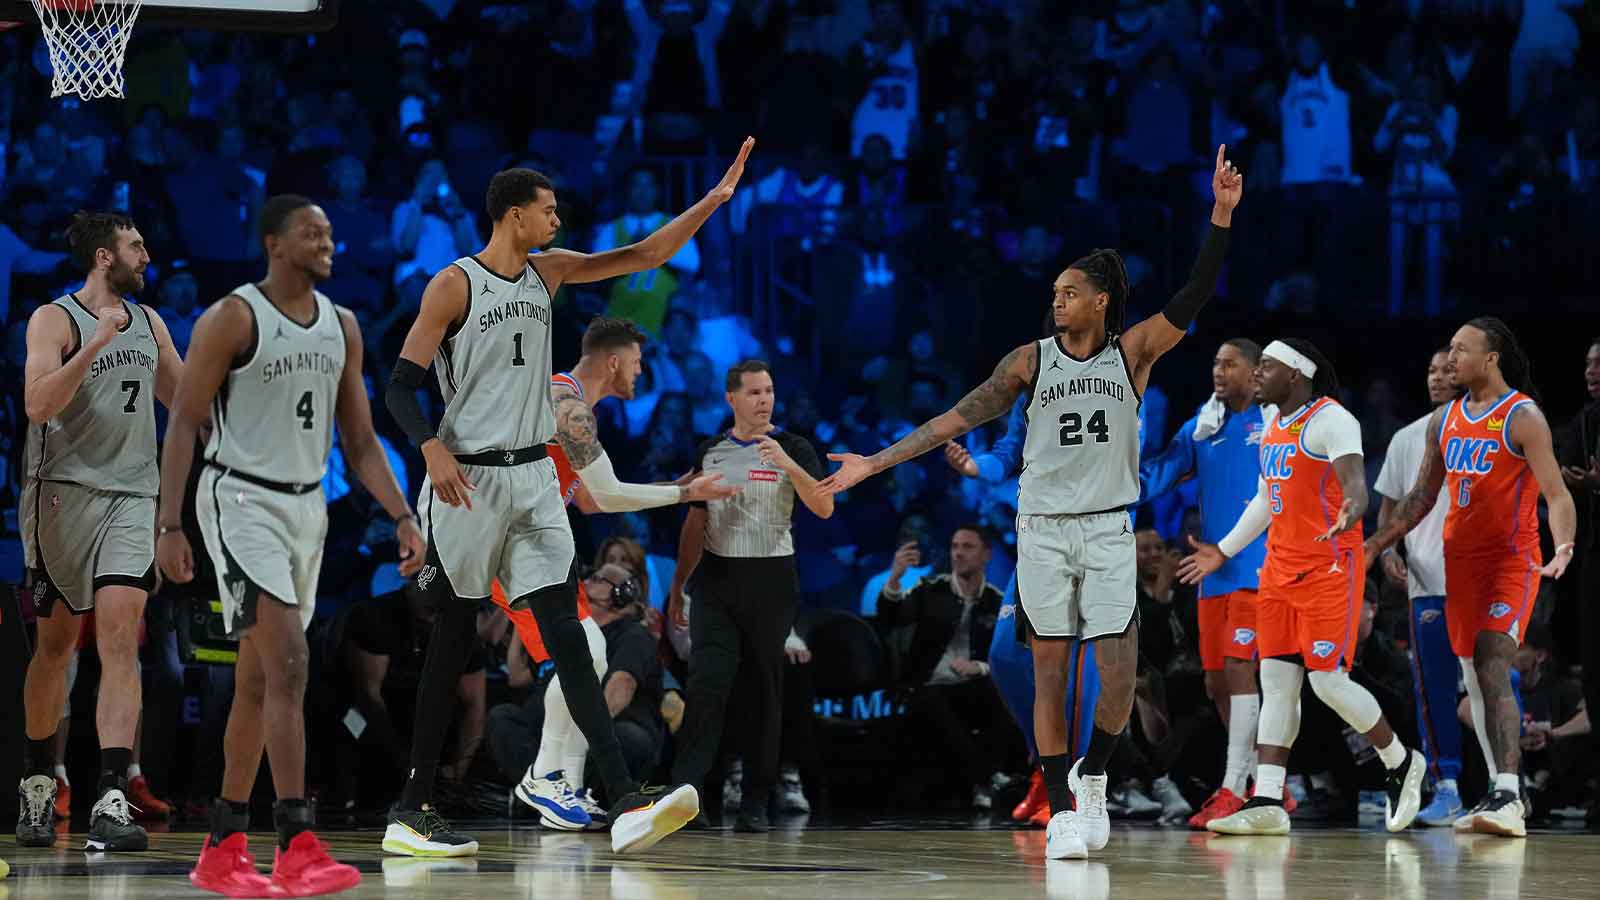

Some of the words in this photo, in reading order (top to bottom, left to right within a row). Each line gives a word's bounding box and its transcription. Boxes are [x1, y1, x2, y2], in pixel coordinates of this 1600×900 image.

[479, 306, 503, 333] SAN
[512, 332, 526, 366] 1
[91, 353, 115, 378] SAN
[263, 355, 292, 384] SAN
[121, 380, 141, 414] 7
[1041, 383, 1065, 408] SAN
[1068, 378, 1123, 402] ANTONIO
[296, 391, 314, 430] 4
[1059, 409, 1109, 446] 24
[1445, 436, 1500, 475] OKC
[1270, 483, 1282, 515] 5
[1458, 477, 1473, 507] 6
